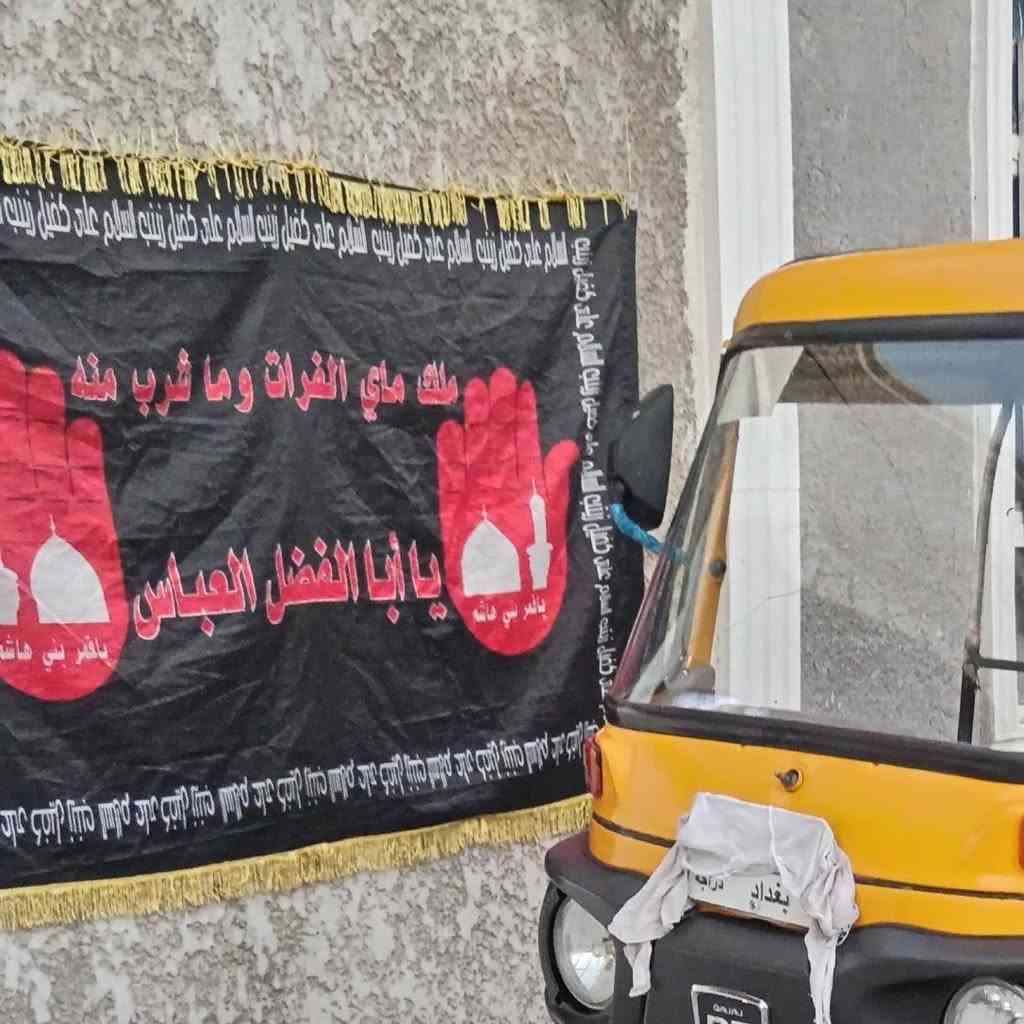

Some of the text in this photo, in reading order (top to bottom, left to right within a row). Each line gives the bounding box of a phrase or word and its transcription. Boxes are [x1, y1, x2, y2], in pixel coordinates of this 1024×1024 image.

[3, 188, 36, 237] زينب
[38, 189, 71, 240] كفيل
[73, 195, 99, 238] على
[138, 203, 166, 248] زينب
[168, 202, 198, 250] كفيل
[200, 203, 224, 245] على
[257, 205, 280, 250] زينب
[282, 204, 310, 252] كفيل
[312, 211, 335, 250] على
[372, 221, 394, 264] زينب
[397, 224, 422, 267] كفيل
[425, 226, 444, 263] على
[476, 231, 498, 272] زينب
[500, 231, 522, 272] كفيل
[524, 232, 542, 268] على
[71, 347, 458, 422] ملك ماي الفرات وما شرب منه
[133, 530, 448, 640] يا أبا الفضل العباس
